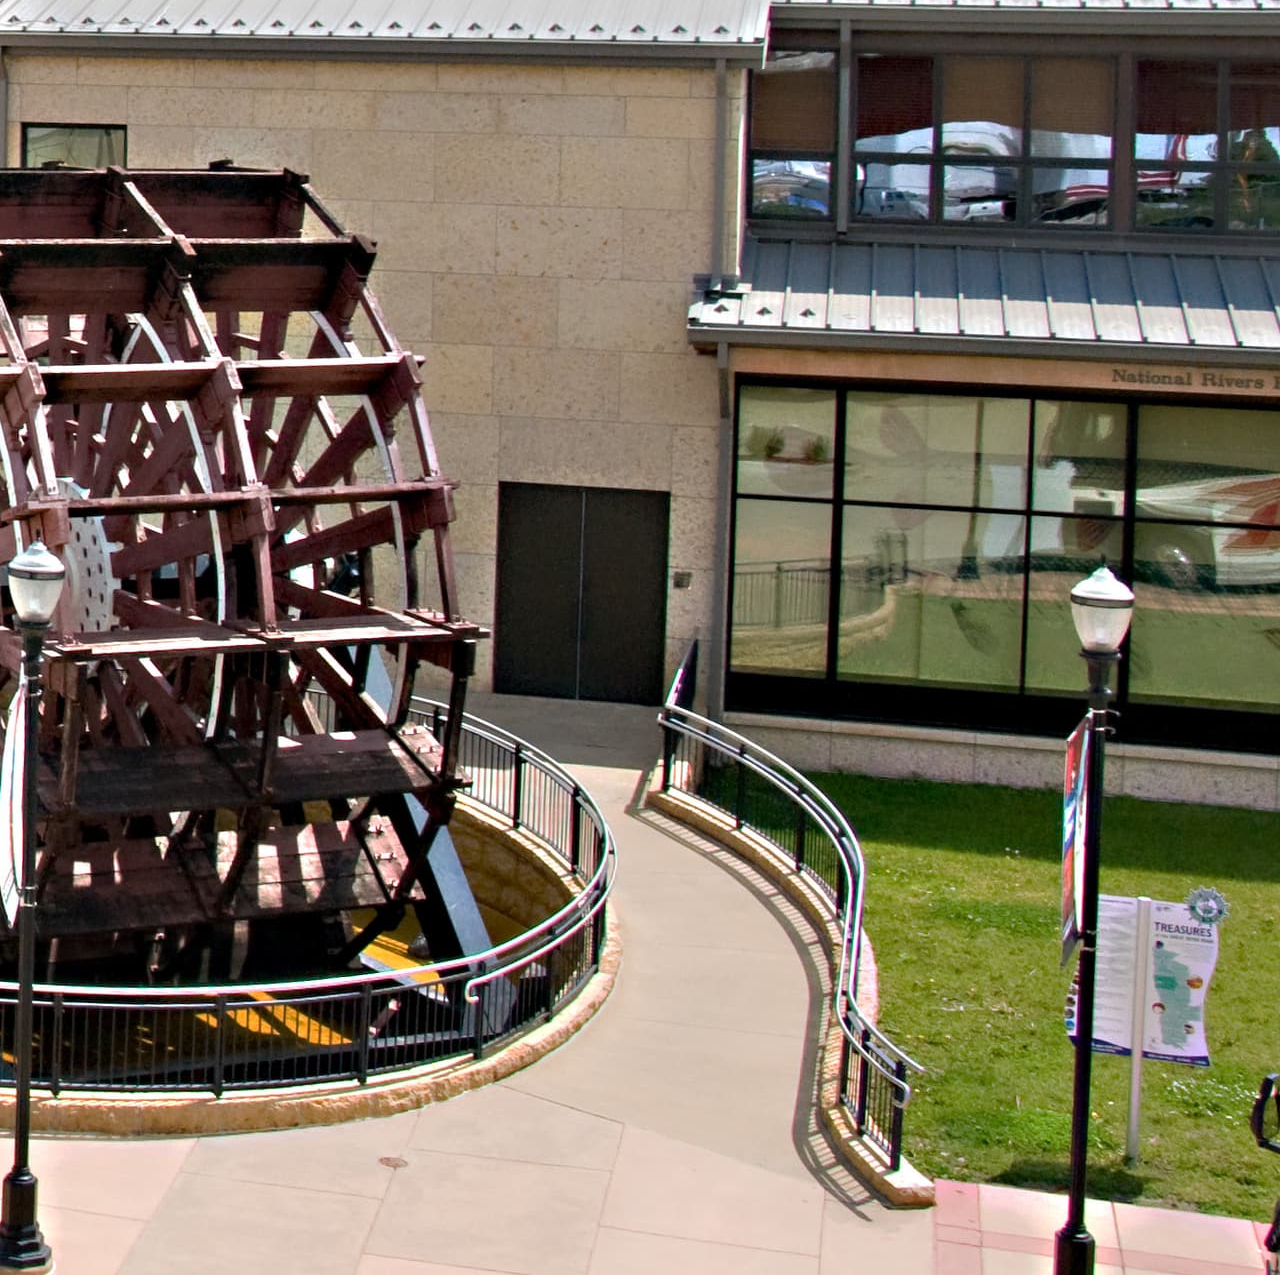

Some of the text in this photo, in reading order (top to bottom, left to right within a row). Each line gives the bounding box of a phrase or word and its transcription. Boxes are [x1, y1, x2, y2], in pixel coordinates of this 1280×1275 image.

[1111, 369, 1192, 386] National
[1201, 373, 1264, 389] Rivers
[1154, 922, 1212, 937] TREASURES
